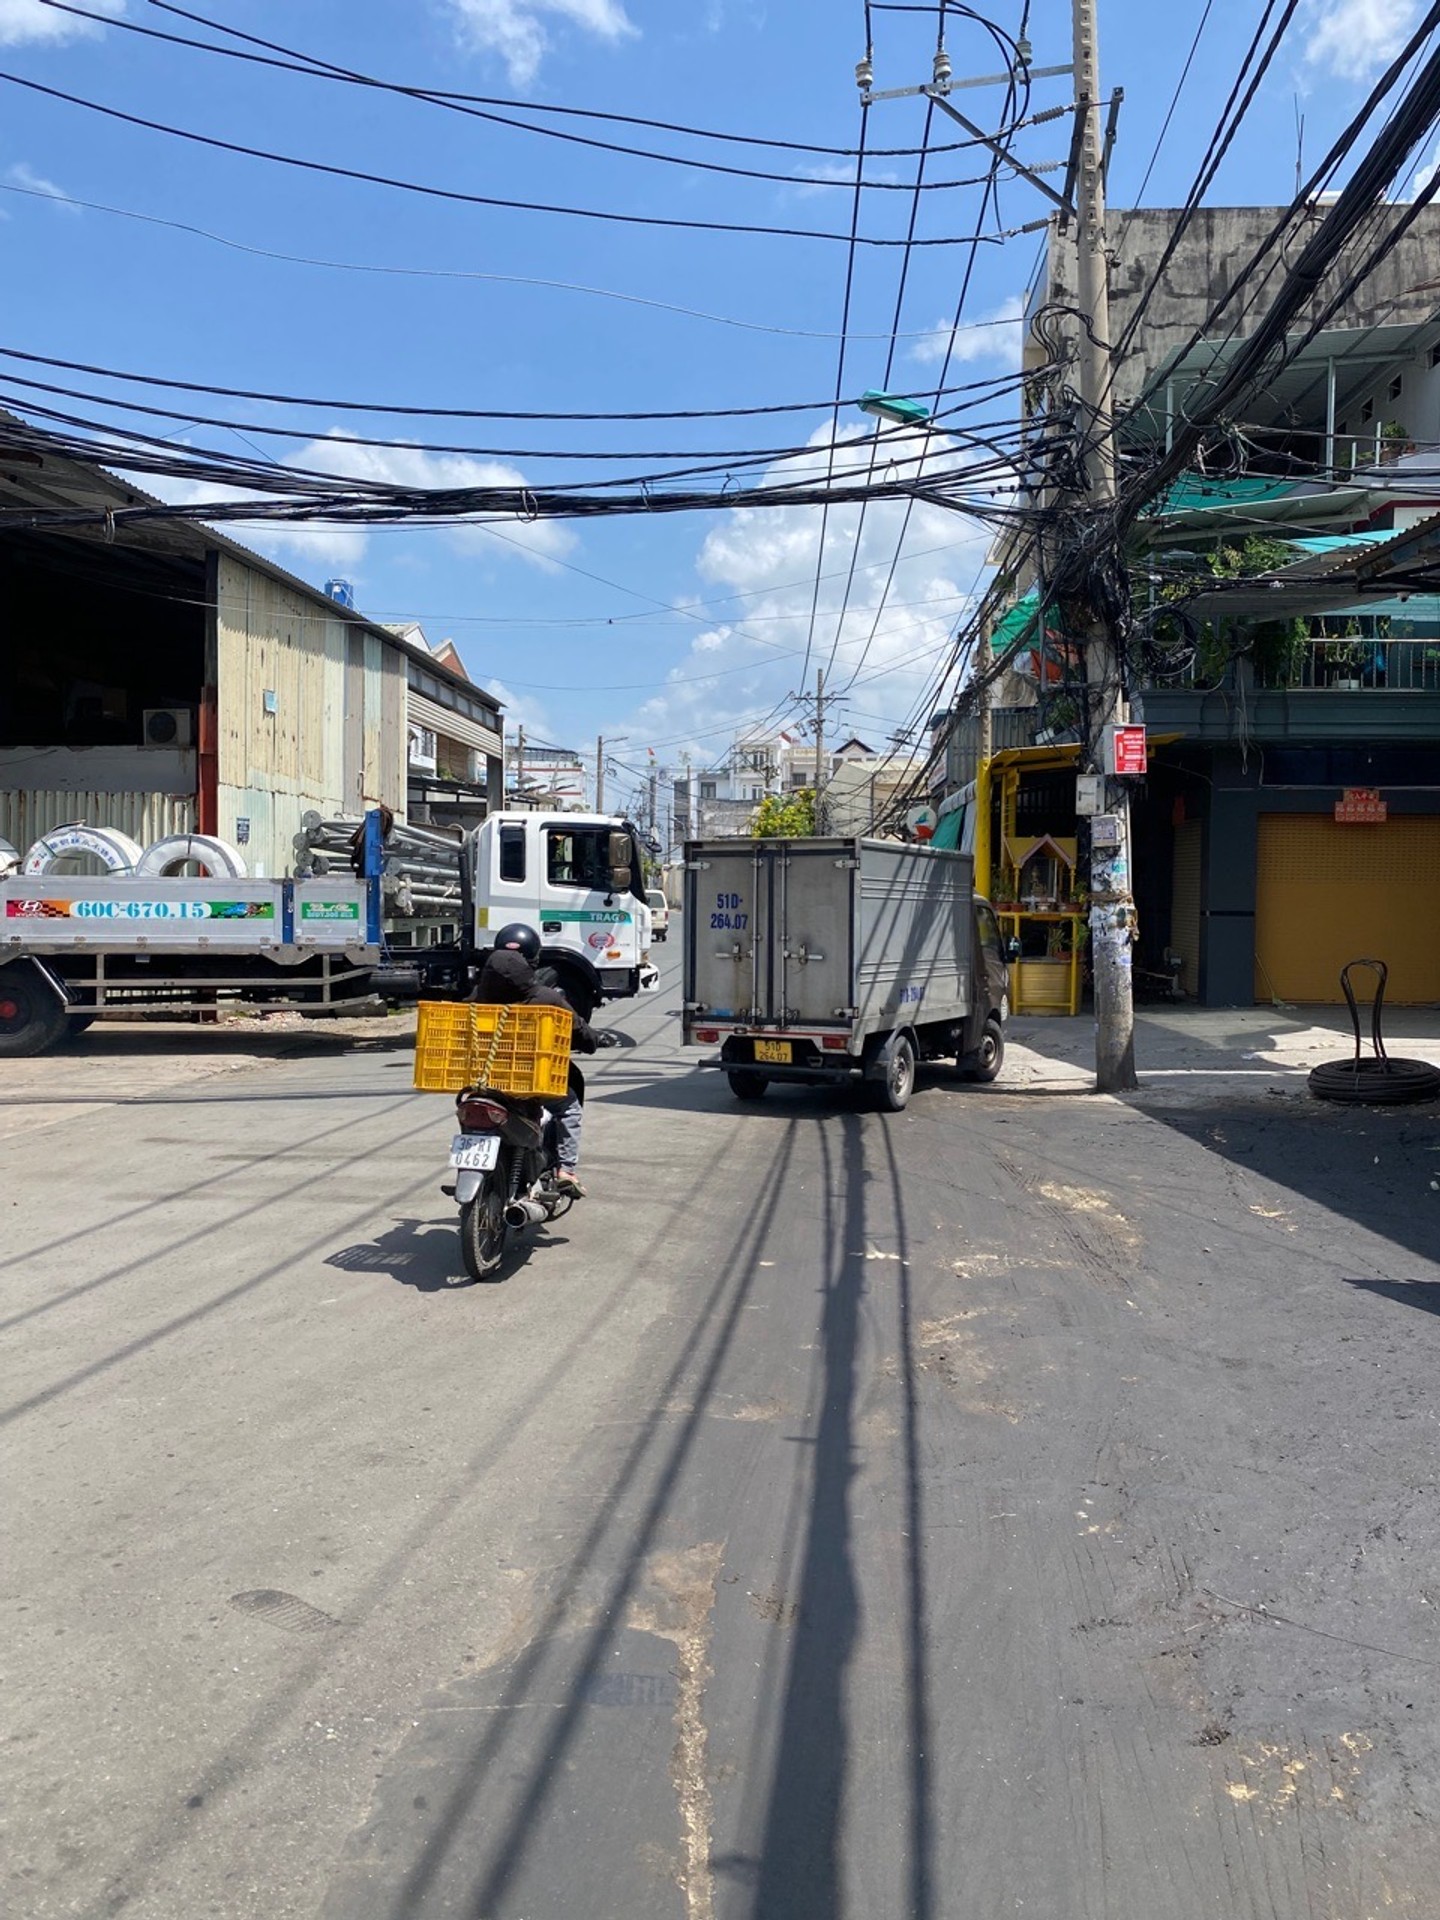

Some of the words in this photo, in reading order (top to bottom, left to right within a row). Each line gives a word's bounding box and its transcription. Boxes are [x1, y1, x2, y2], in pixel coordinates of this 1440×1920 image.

[77, 901, 205, 918] 60C-670.15
[710, 913, 748, 930] 264.07
[765, 1041, 781, 1051] 51D
[455, 1152, 489, 1167] 0462
